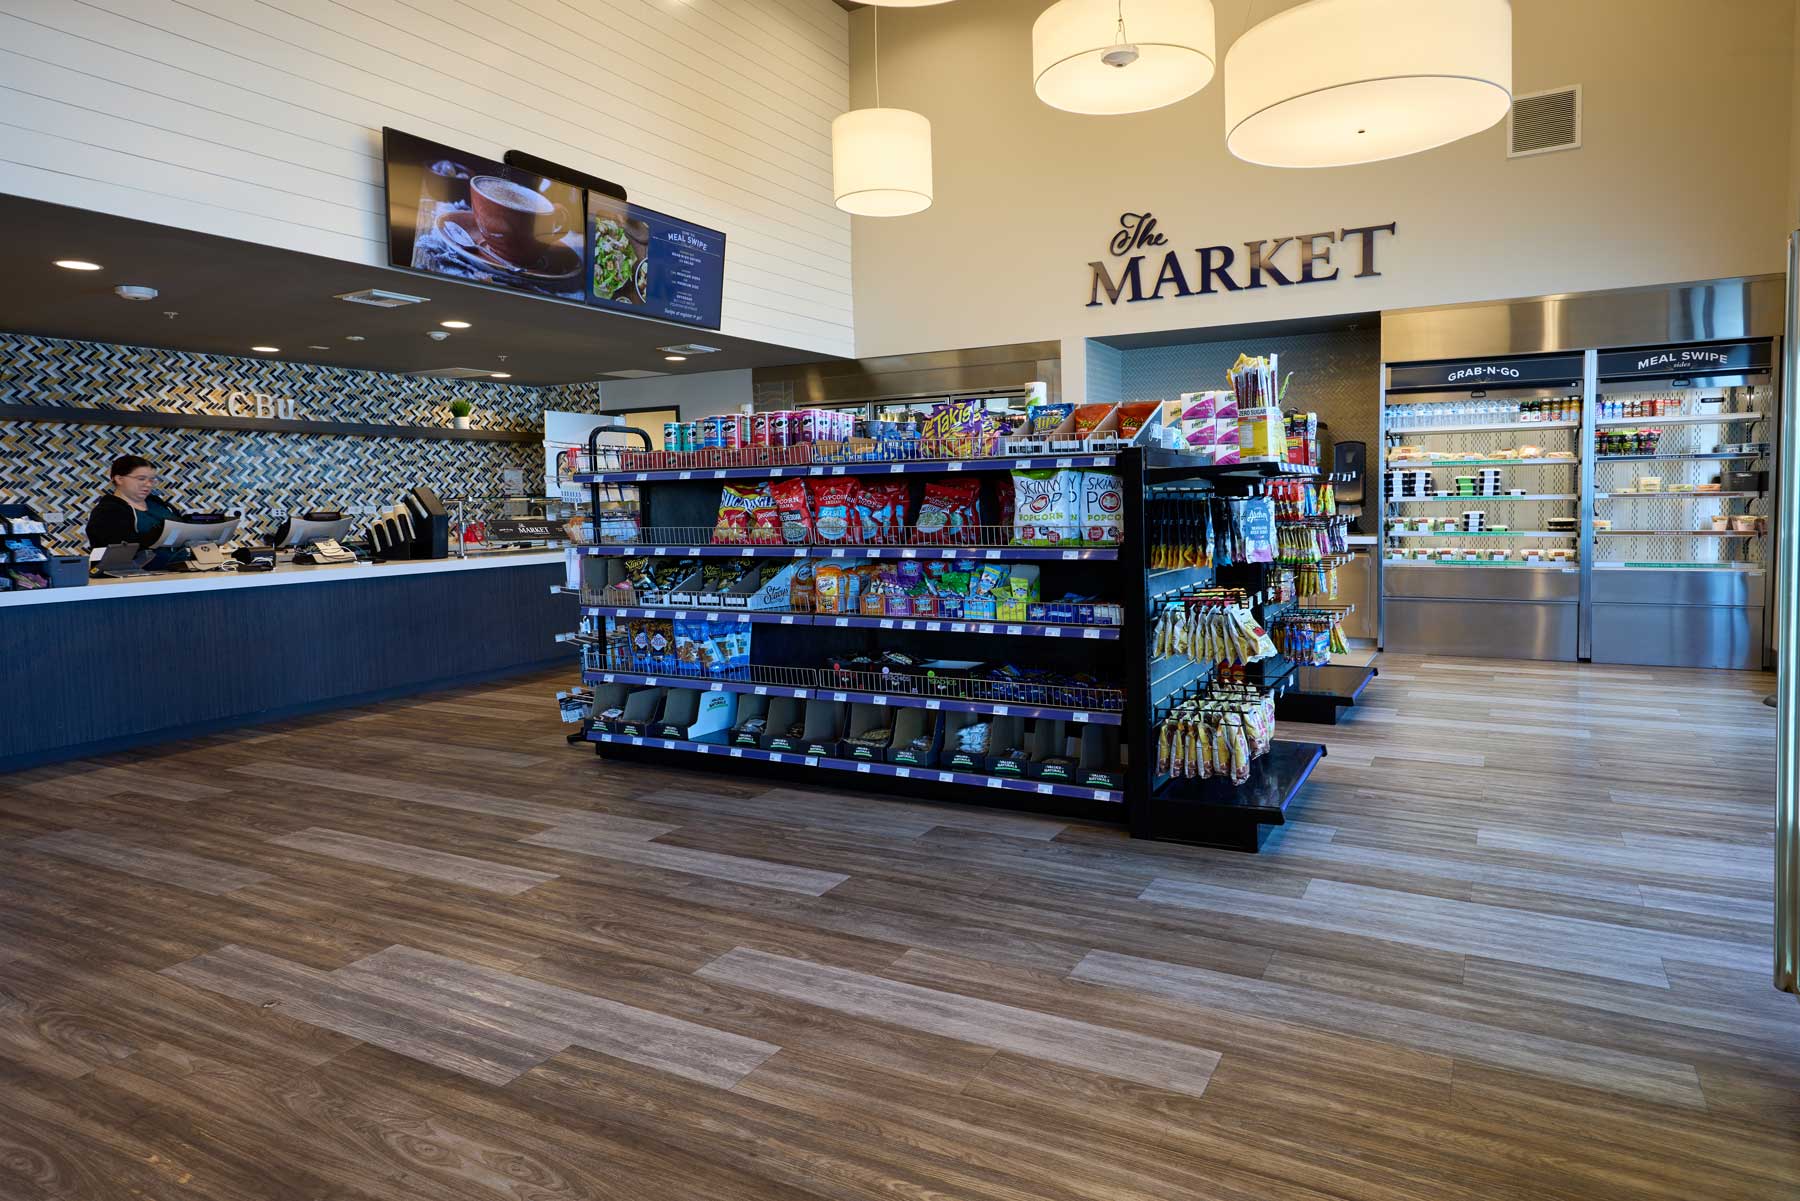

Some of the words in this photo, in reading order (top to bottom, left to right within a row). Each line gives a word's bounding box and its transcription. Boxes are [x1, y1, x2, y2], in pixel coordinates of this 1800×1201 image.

[667, 233, 686, 242] MEAL
[687, 236, 708, 251] SWIPE
[1110, 212, 1168, 256] The
[1085, 221, 1396, 307] MARKET
[1637, 353, 1677, 370] MEAL
[1681, 351, 1728, 364] SWIPE
[1447, 366, 1520, 381] GRAB-N-GO
[1020, 476, 1062, 495] SKINNY
[1018, 492, 1062, 514] POP
[1086, 490, 1121, 514] PO
[1018, 512, 1063, 521] POPCORN
